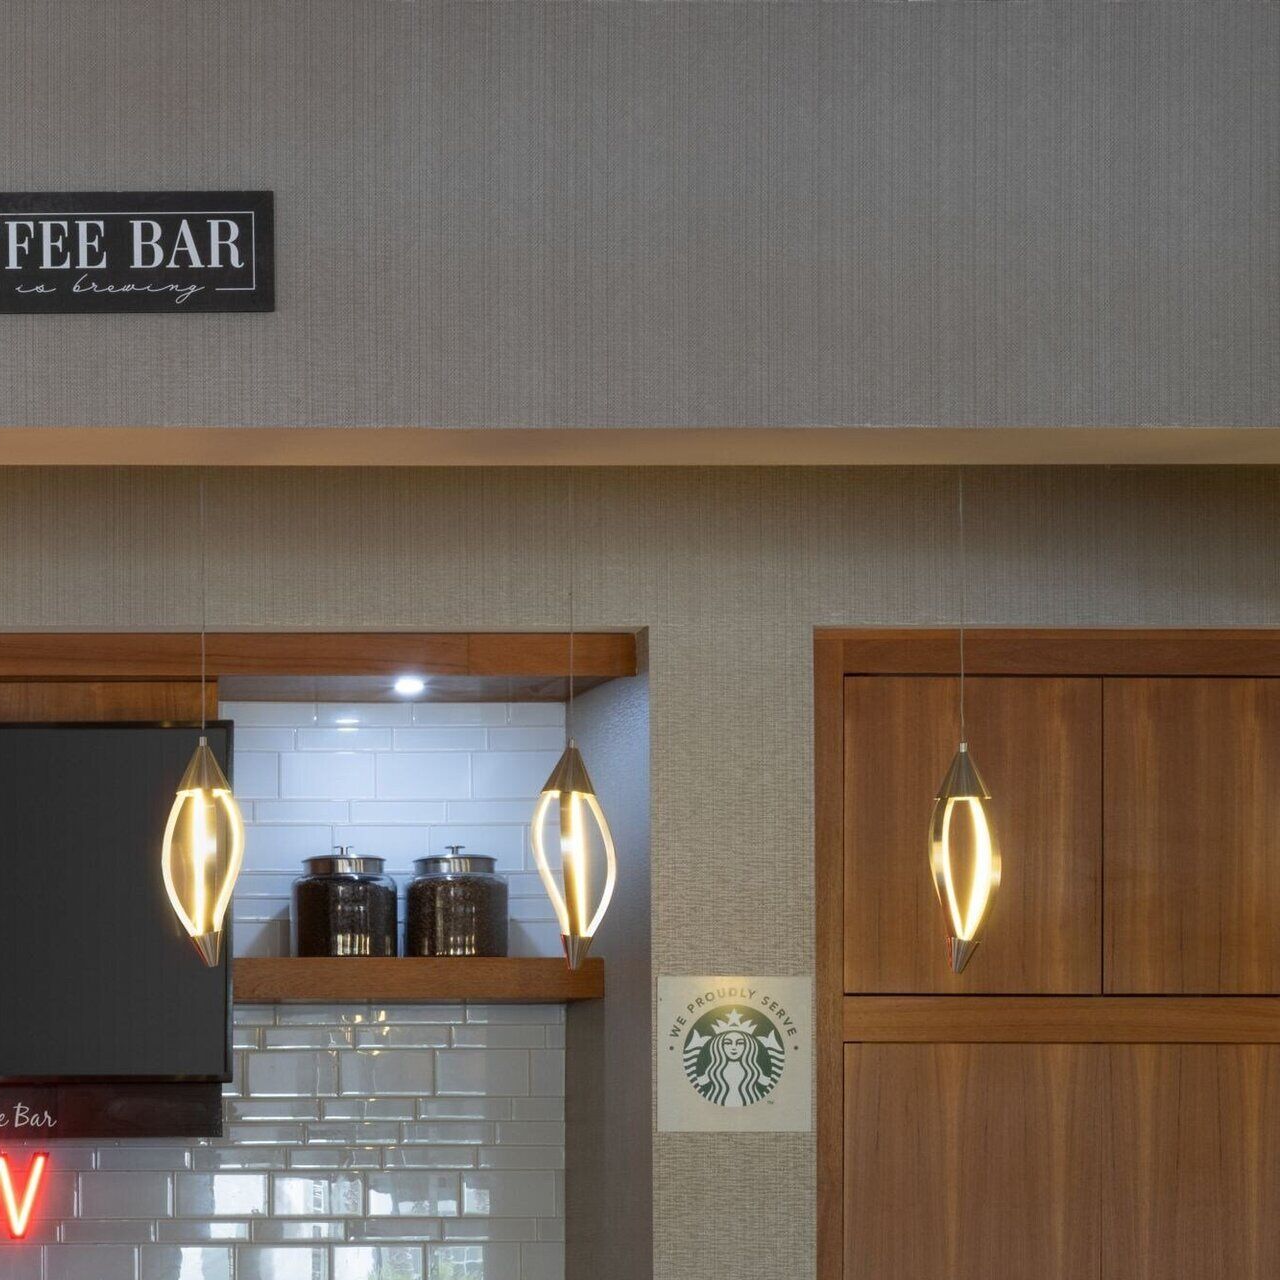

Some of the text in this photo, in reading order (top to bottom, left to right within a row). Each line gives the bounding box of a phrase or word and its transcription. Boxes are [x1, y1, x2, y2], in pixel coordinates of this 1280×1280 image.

[129, 219, 245, 269] BAR
[15, 282, 56, 294] is
[73, 274, 206, 304] brewing
[670, 987, 797, 1038] WE PROUDLY SERVE
[13, 1102, 58, 1129] Bar
